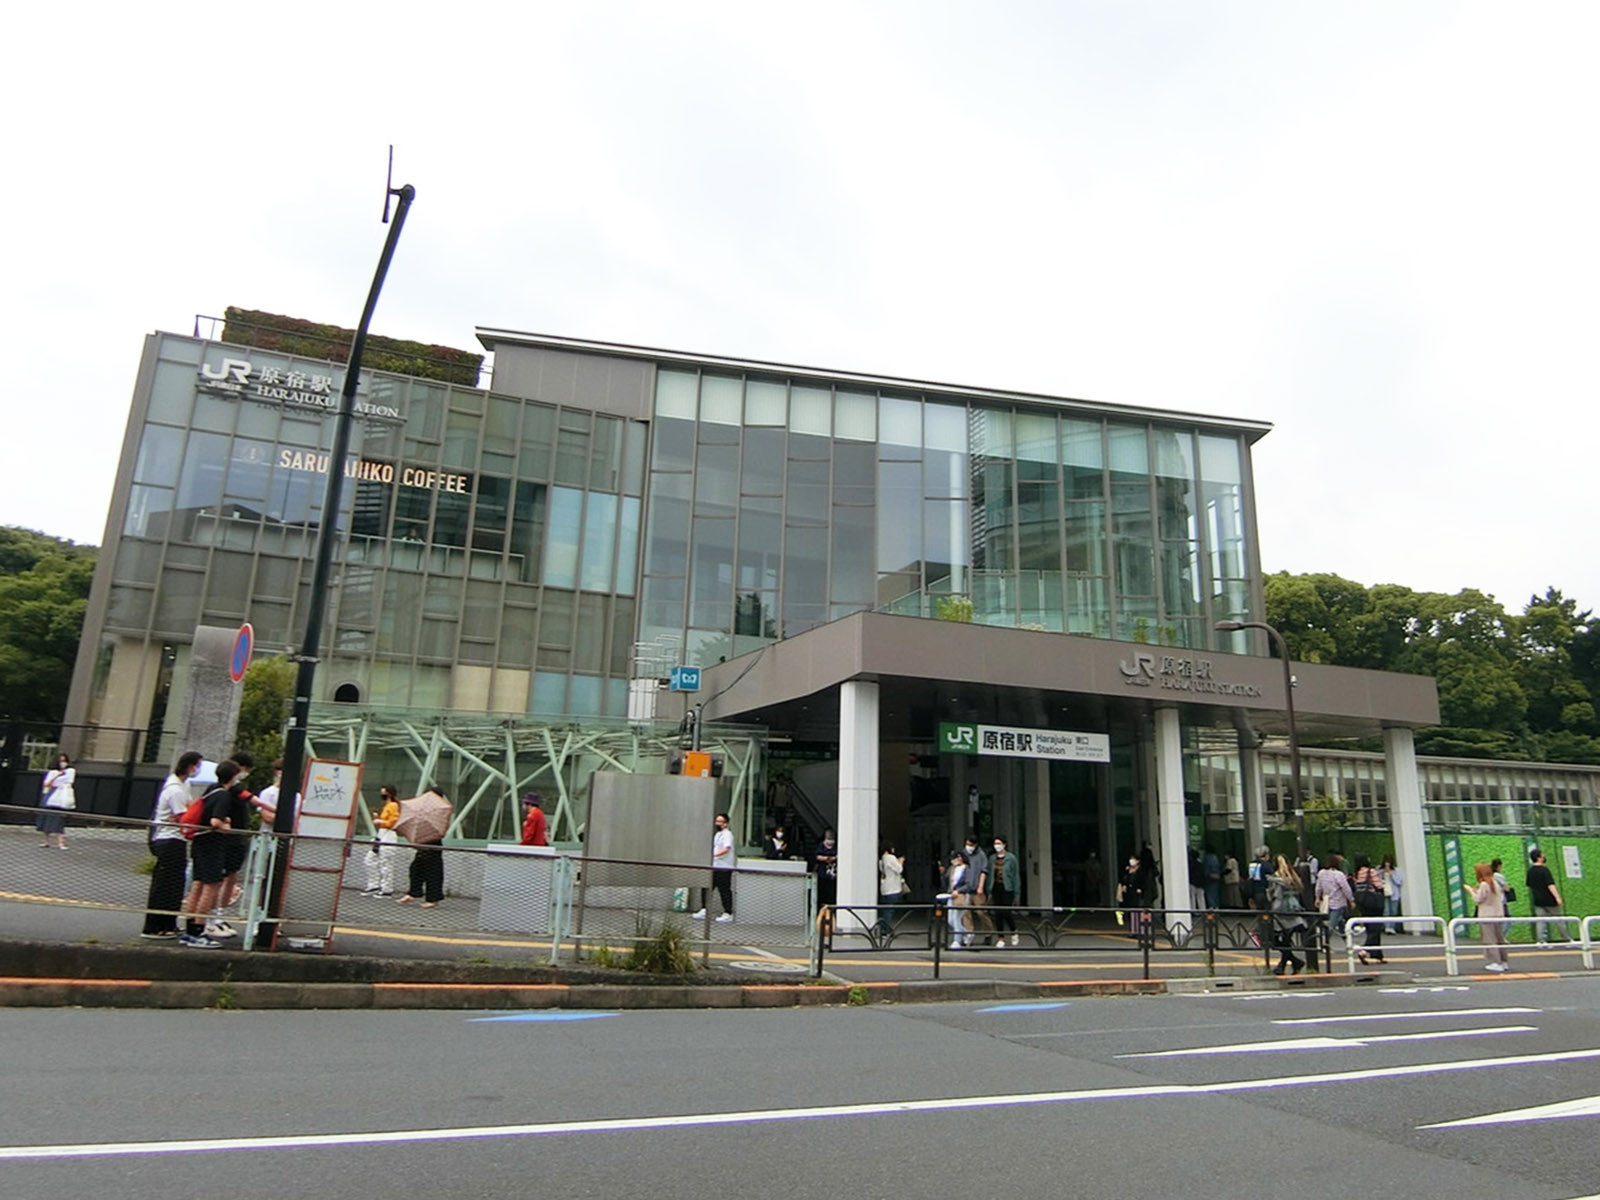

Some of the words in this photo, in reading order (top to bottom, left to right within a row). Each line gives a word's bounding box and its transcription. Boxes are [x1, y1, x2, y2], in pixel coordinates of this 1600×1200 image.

[202, 358, 252, 384] JR
[260, 366, 333, 394] 原宿駅
[257, 385, 335, 407] HARAJUKU
[354, 402, 399, 417] ATION
[280, 450, 394, 483] SARUAHIKO
[402, 468, 467, 493] COFFEE
[1120, 652, 1155, 678] JR
[1160, 656, 1212, 678] 原宿駅
[947, 726, 974, 744] JR
[983, 730, 1032, 751] 原宿駅
[1036, 734, 1072, 745] Harajuku
[1036, 744, 1066, 755] Station
